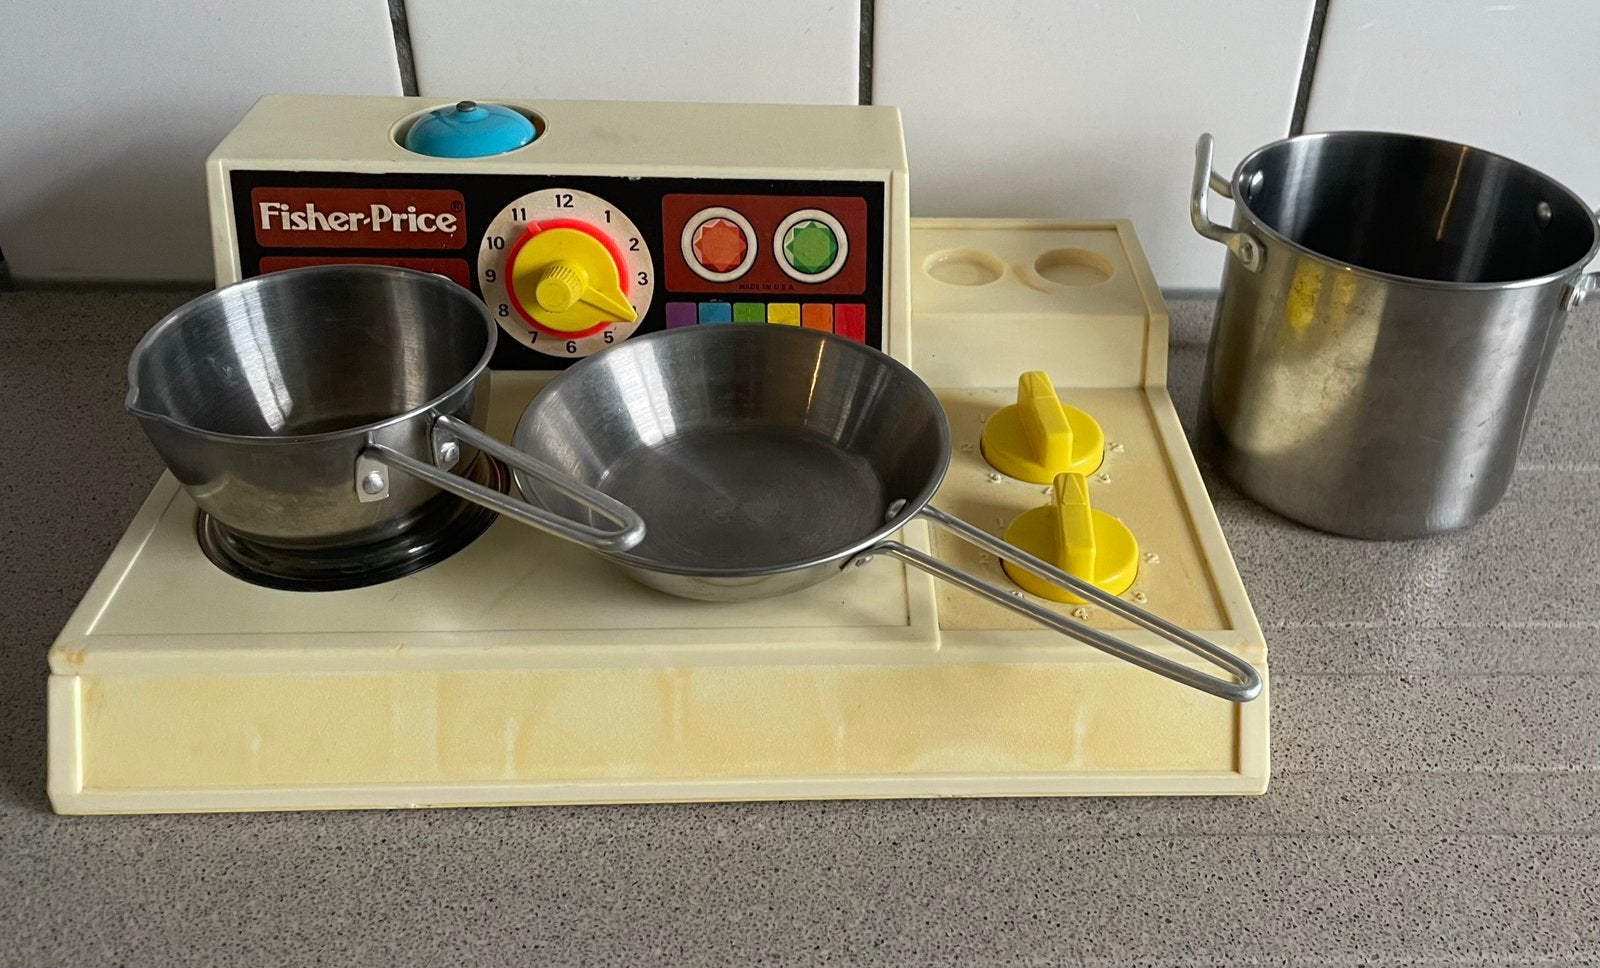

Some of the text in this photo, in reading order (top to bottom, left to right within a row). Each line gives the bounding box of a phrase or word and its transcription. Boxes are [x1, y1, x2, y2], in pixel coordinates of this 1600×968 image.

[555, 194, 574, 208] 12
[512, 208, 526, 221] 11
[605, 210, 611, 223] 1
[487, 236, 505, 250] 10
[629, 238, 640, 251] 2
[485, 269, 497, 283] 9
[637, 271, 648, 286] 3
[498, 304, 510, 317] 8
[528, 331, 538, 344] 7
[604, 331, 614, 344] 5
[565, 341, 577, 354] 6
[1073, 607, 1088, 620] 4
